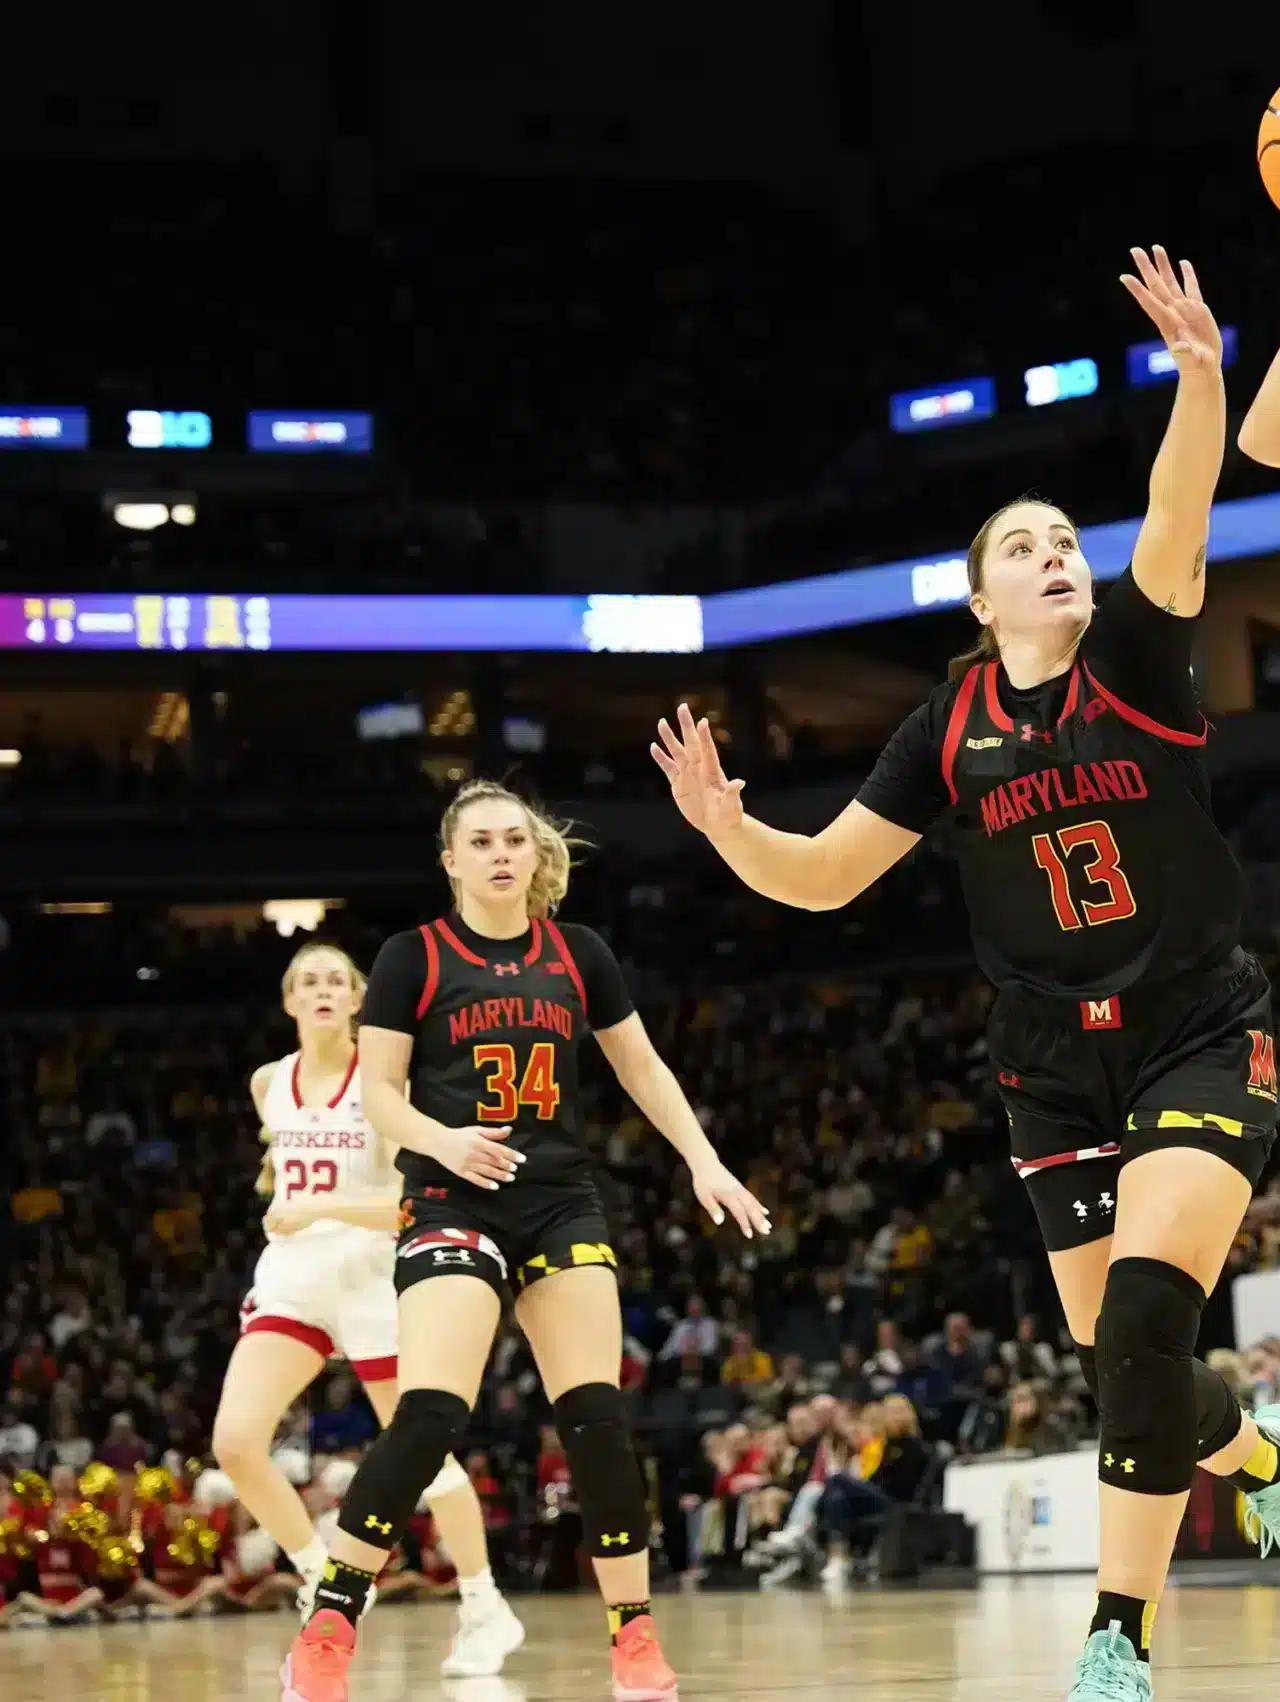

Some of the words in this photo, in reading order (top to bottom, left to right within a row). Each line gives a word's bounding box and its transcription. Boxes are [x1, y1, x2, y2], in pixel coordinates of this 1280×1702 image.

[980, 760, 1148, 838] MARYLAND
[1031, 819, 1137, 931] 13
[448, 996, 573, 1045] MARYLAND
[473, 1042, 560, 1123] 34
[1247, 1029, 1278, 1094] M
[284, 1159, 338, 1201] 22
